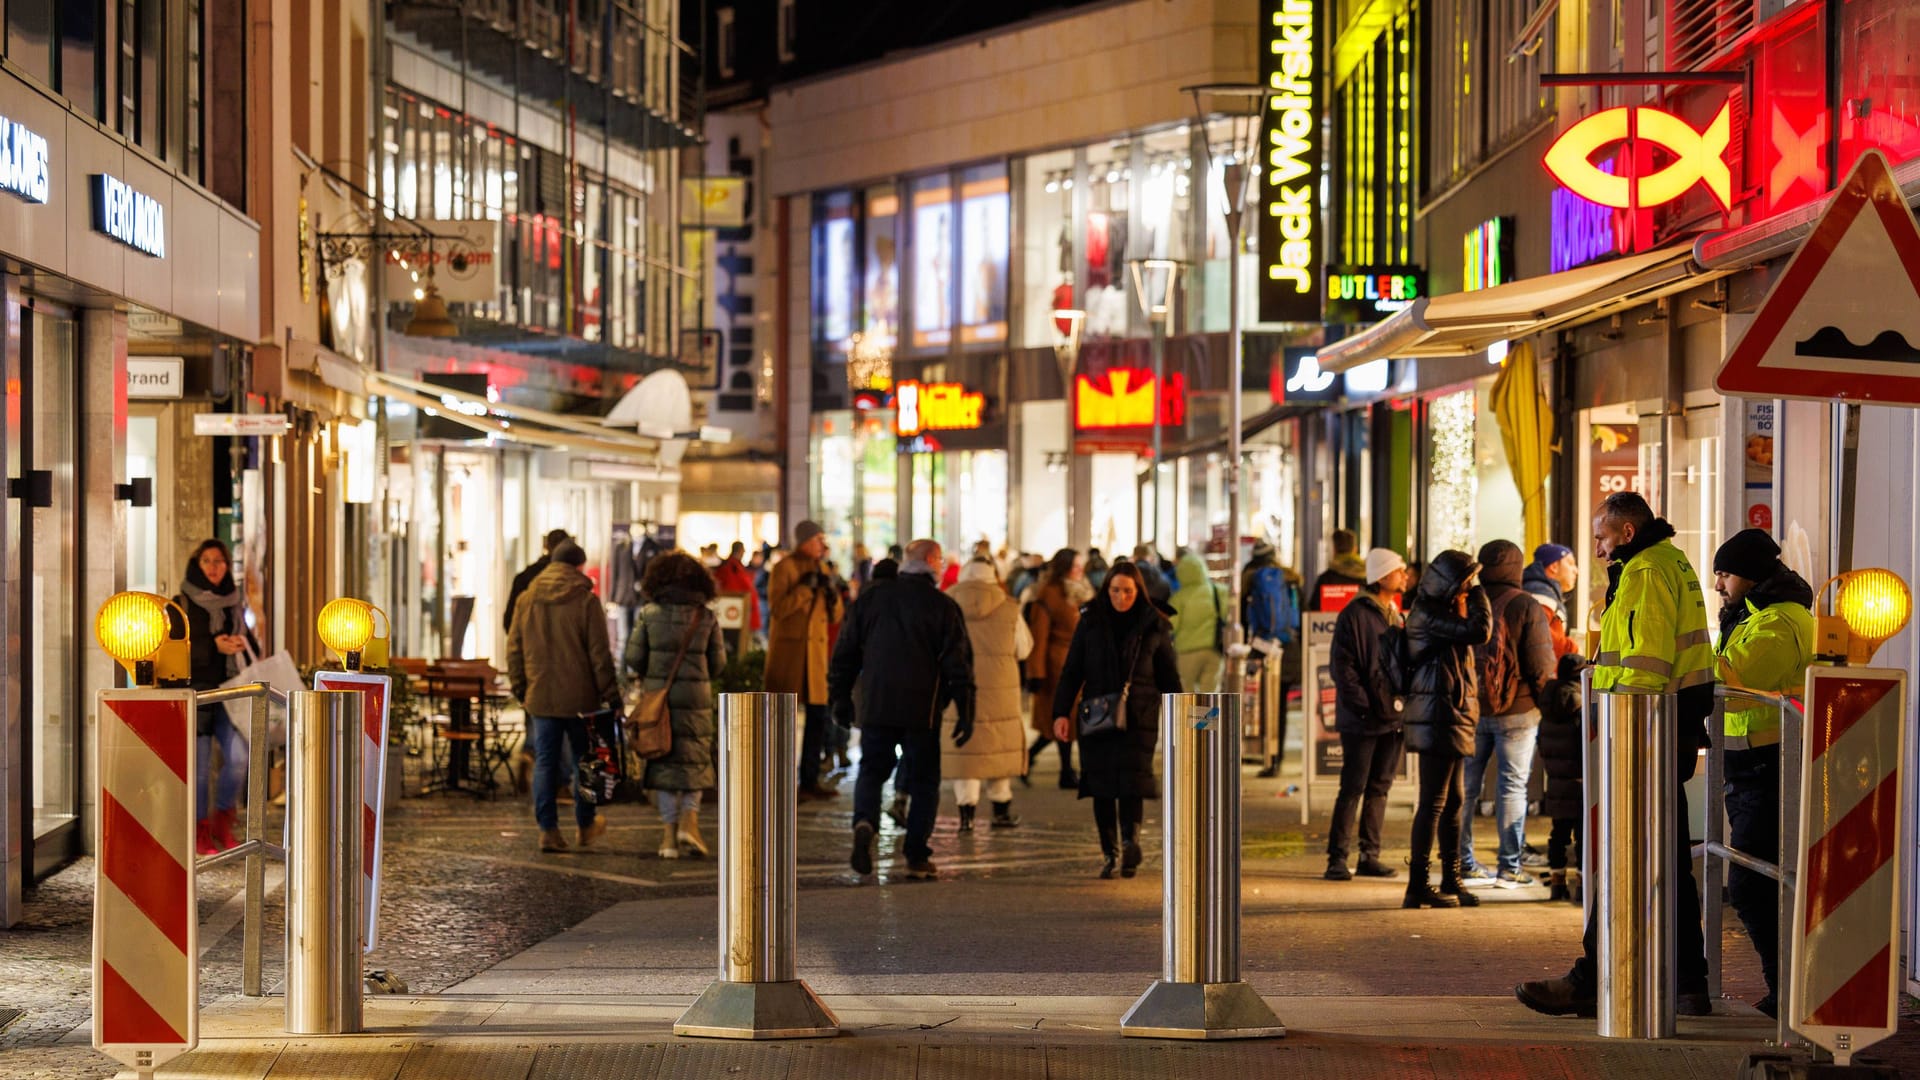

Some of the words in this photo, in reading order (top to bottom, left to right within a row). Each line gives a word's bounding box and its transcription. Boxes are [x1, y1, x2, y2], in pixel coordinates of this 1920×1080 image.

[102, 172, 134, 245] VERO
[133, 191, 166, 259] MODA
[1269, 185, 1312, 293] Jack
[1329, 274, 1418, 300] BUTLERS
[1757, 421, 1774, 430] BO
[1600, 474, 1627, 492] SO
